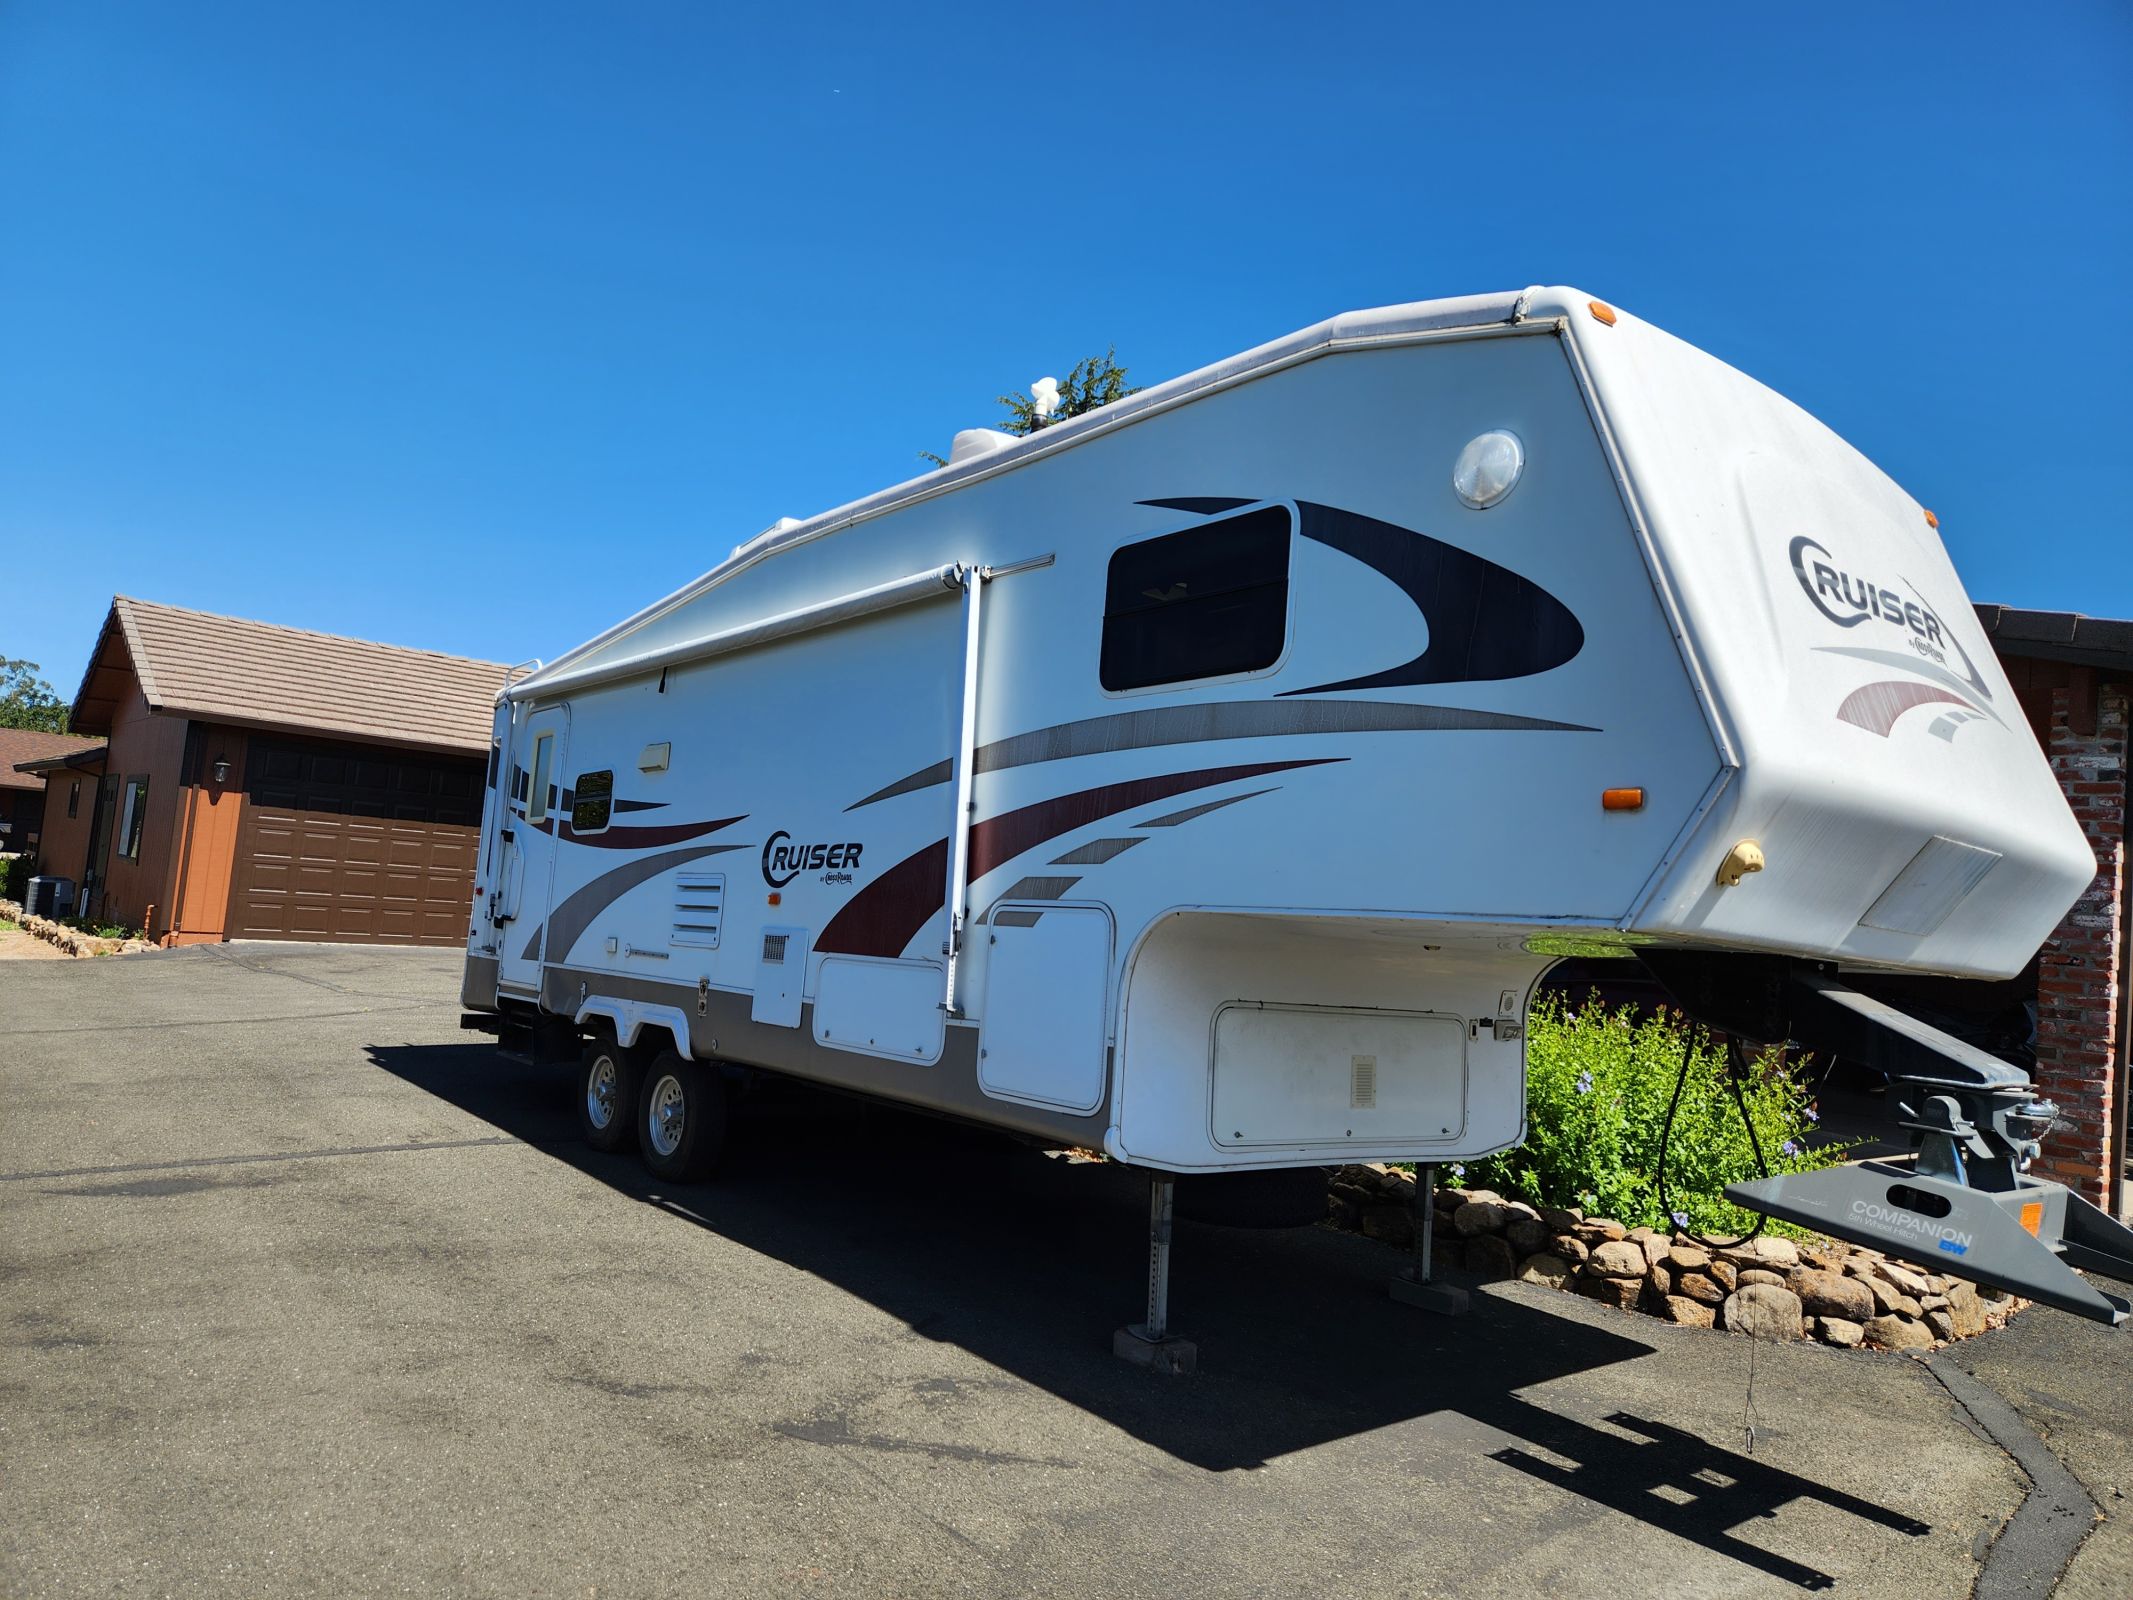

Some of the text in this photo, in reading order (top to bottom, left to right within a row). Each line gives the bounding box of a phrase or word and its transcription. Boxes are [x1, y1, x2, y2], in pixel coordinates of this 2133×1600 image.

[1789, 535, 1946, 650] CRUISER
[762, 831, 863, 888] CRUISER
[1852, 1200, 1973, 1247] COMPANION
[1864, 1218, 1893, 1233] Wheel
[1893, 1227, 1918, 1241] Hitch
